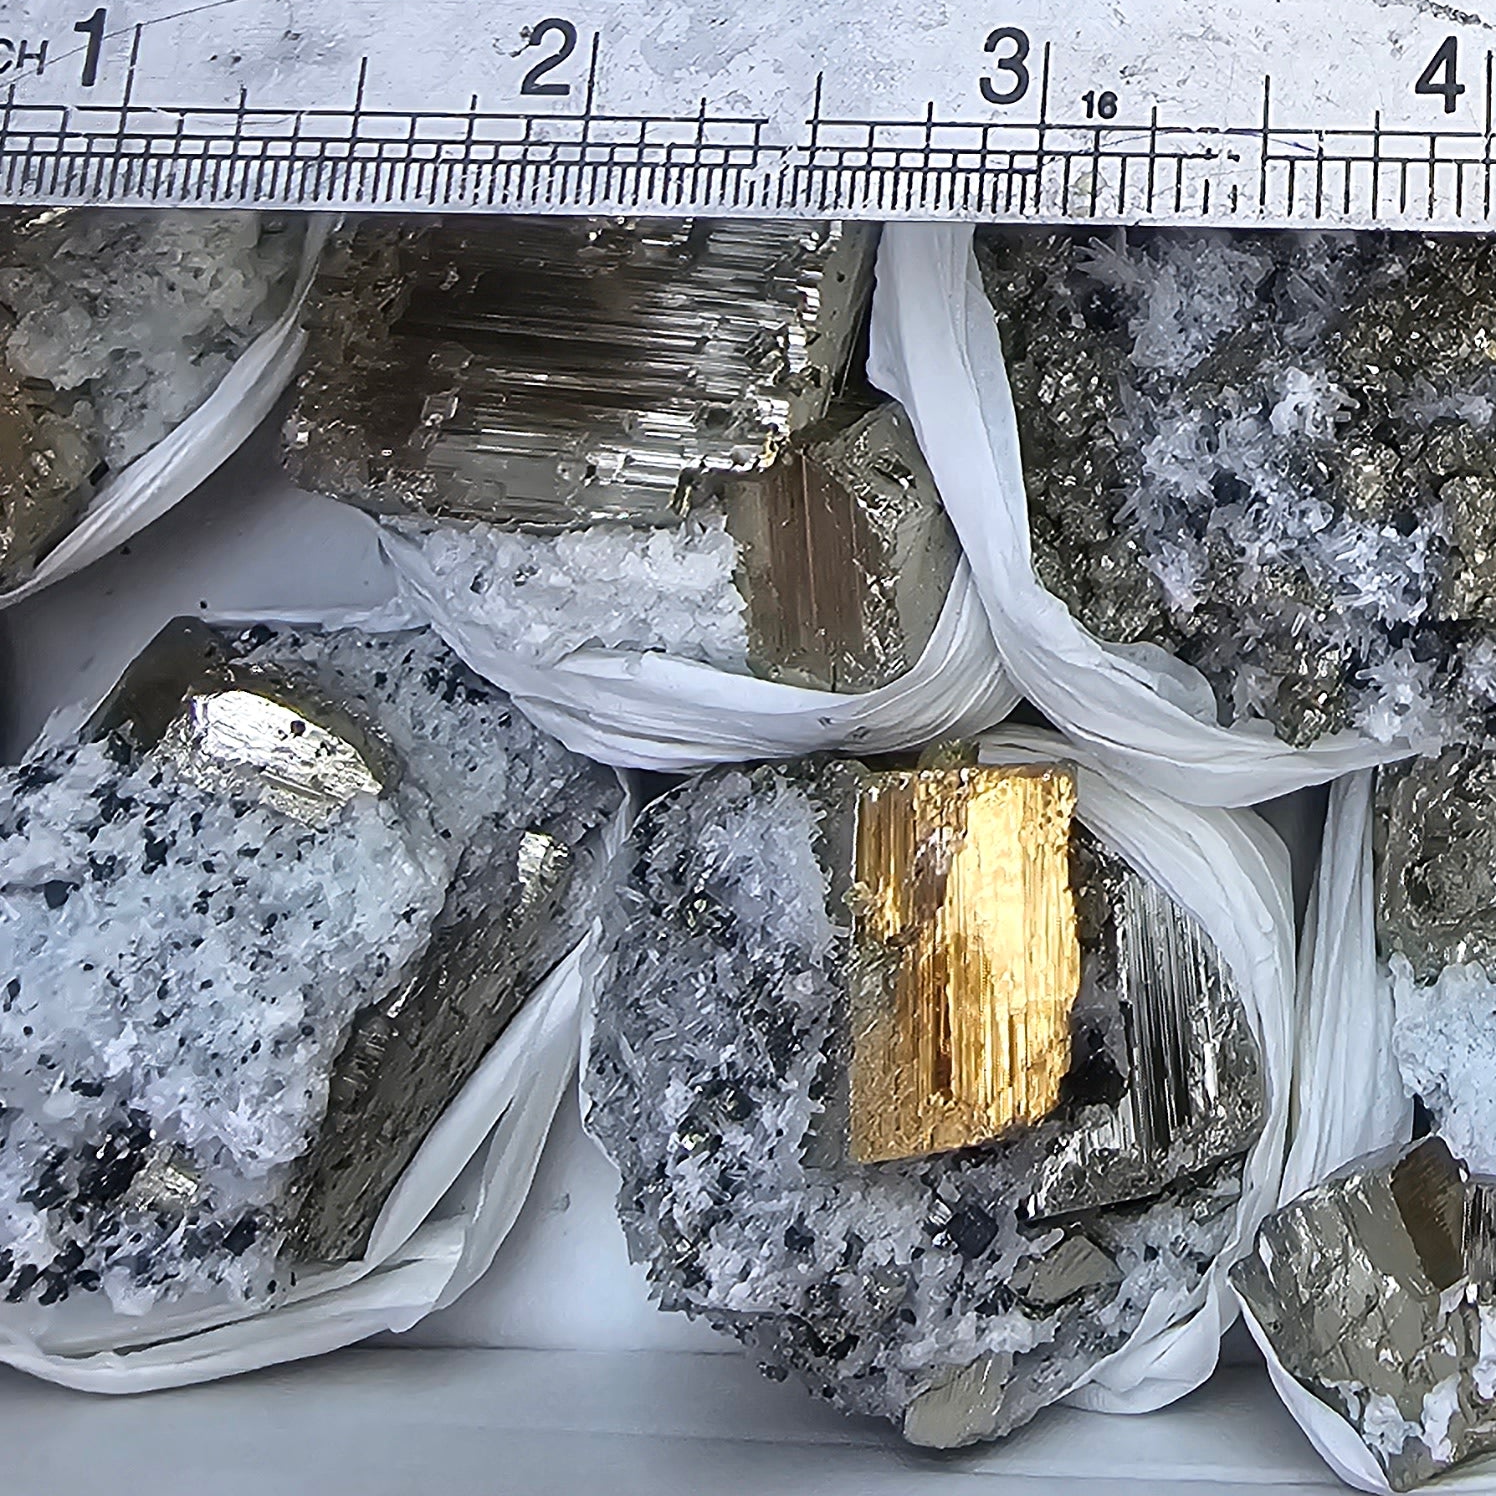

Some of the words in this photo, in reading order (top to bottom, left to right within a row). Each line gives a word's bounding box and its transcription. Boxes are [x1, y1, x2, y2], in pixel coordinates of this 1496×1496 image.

[74, 8, 107, 87] 1
[520, 18, 577, 96] 2
[979, 27, 1029, 105] 3
[1081, 91, 1118, 120] 16
[1415, 36, 1465, 113] 4
